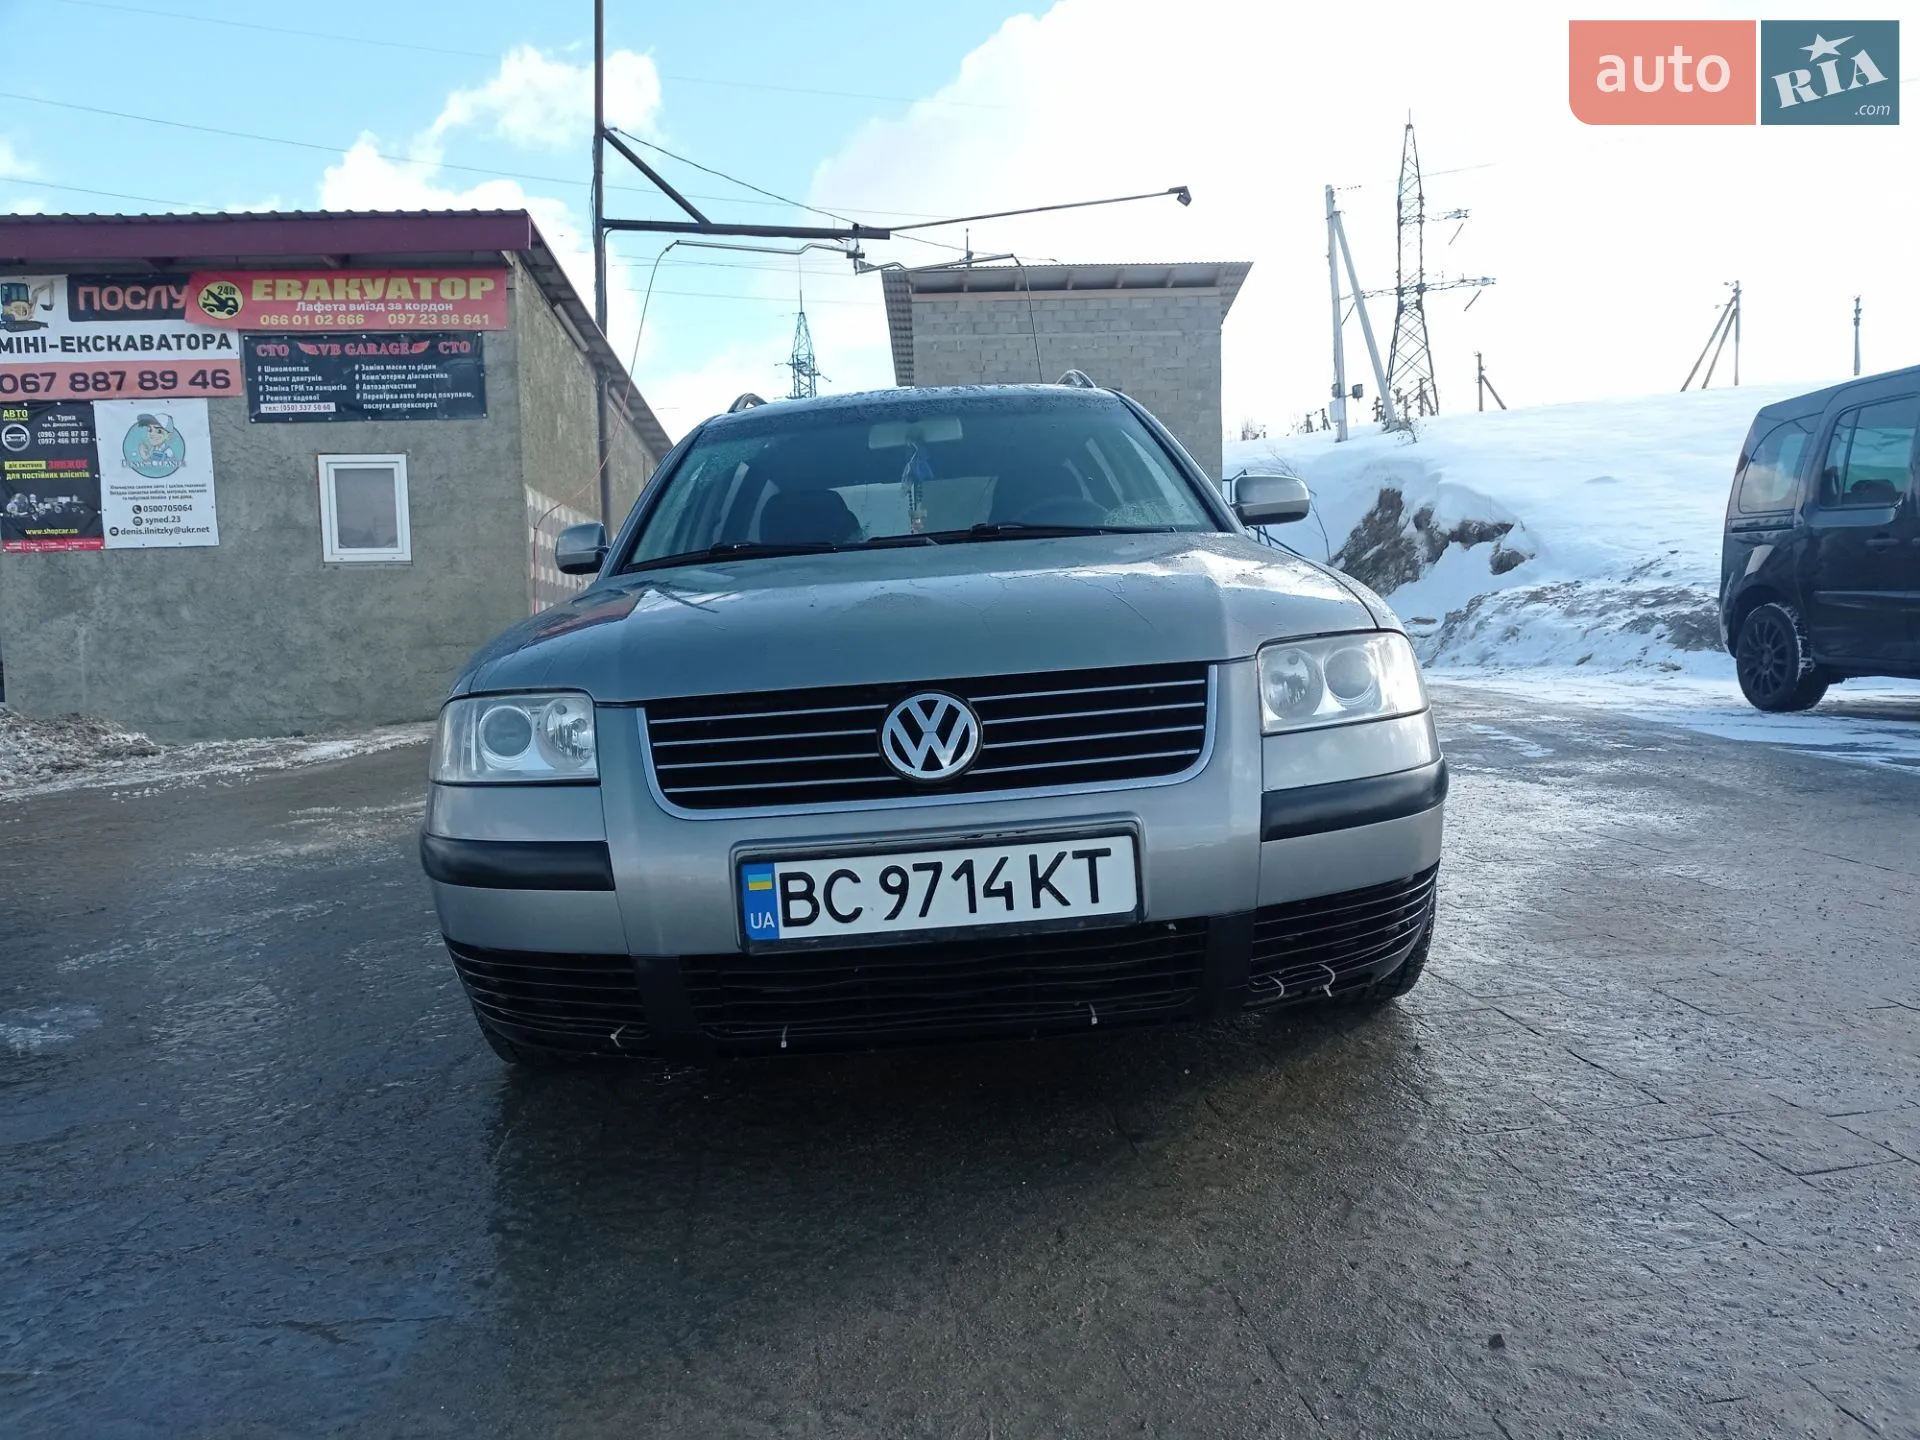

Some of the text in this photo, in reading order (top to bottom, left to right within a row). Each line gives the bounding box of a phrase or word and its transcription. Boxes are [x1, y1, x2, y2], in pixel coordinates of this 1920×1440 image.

[252, 277, 495, 301] ЕВАКУАТОР
[296, 301, 453, 313] Лафета виїзд за кордон
[260, 313, 365, 326] 066 01 02 666
[388, 313, 489, 325] 097 23 96 641
[0, 333, 233, 355] МІНІ-ЕКСКАВАТОРА
[256, 344, 290, 356] СТО
[344, 342, 411, 355] GARAGE
[438, 341, 471, 354] СТО
[264, 365, 310, 373] Шиномонтаж
[0, 369, 231, 394] 067 887 89 46
[407, 372, 448, 381] діагностика
[264, 384, 290, 392] Заміна
[266, 394, 291, 402] Ремонт
[416, 392, 437, 401] перед
[3, 409, 28, 418] АВТО
[143, 504, 193, 513] 0500705064
[145, 515, 181, 525] syned.23
[120, 525, 210, 536] denis.ilnitzky@ukr.net
[779, 847, 1112, 928] BC 9714 KT
[750, 912, 775, 930] UA
